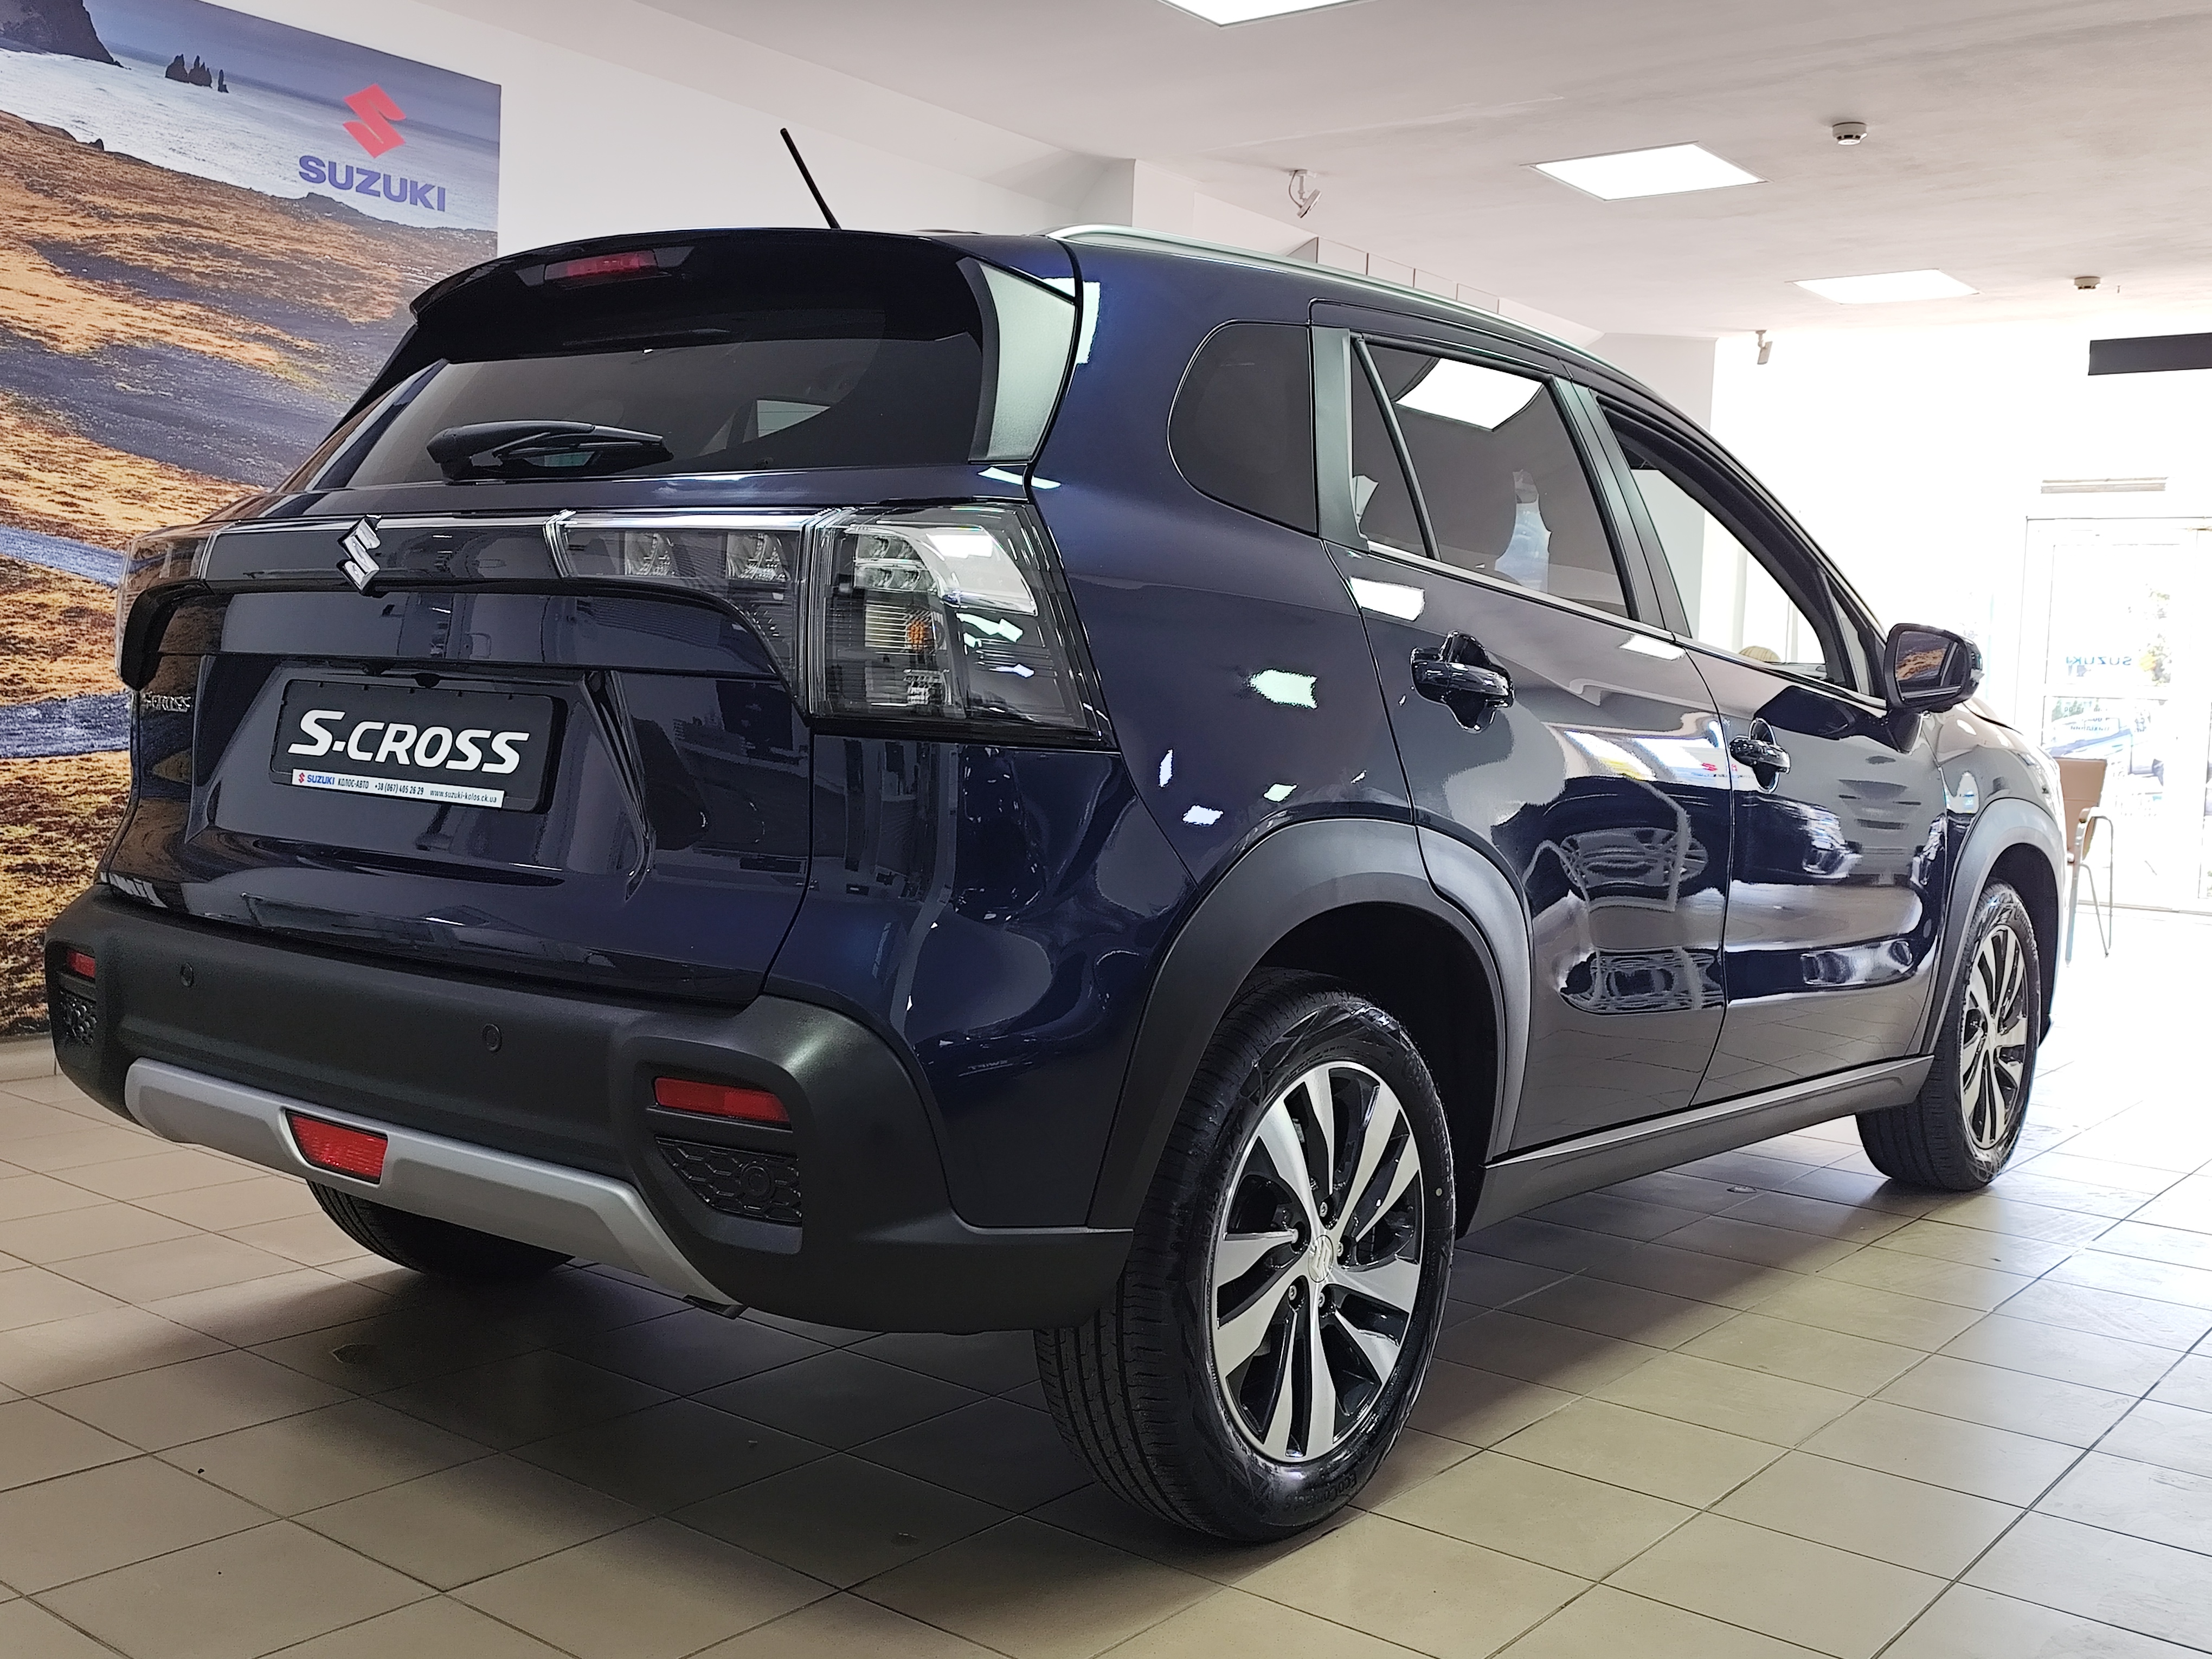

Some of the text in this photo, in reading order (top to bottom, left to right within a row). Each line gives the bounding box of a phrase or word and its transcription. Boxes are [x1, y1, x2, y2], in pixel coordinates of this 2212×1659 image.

[299, 155, 446, 212] SUZUKI
[307, 774, 335, 785] SUZUKI
[338, 778, 369, 789] КОЛОС-АВТО
[375, 782, 383, 791] +38
[430, 790, 497, 803] www.suzuki-kolos.ck.ua
